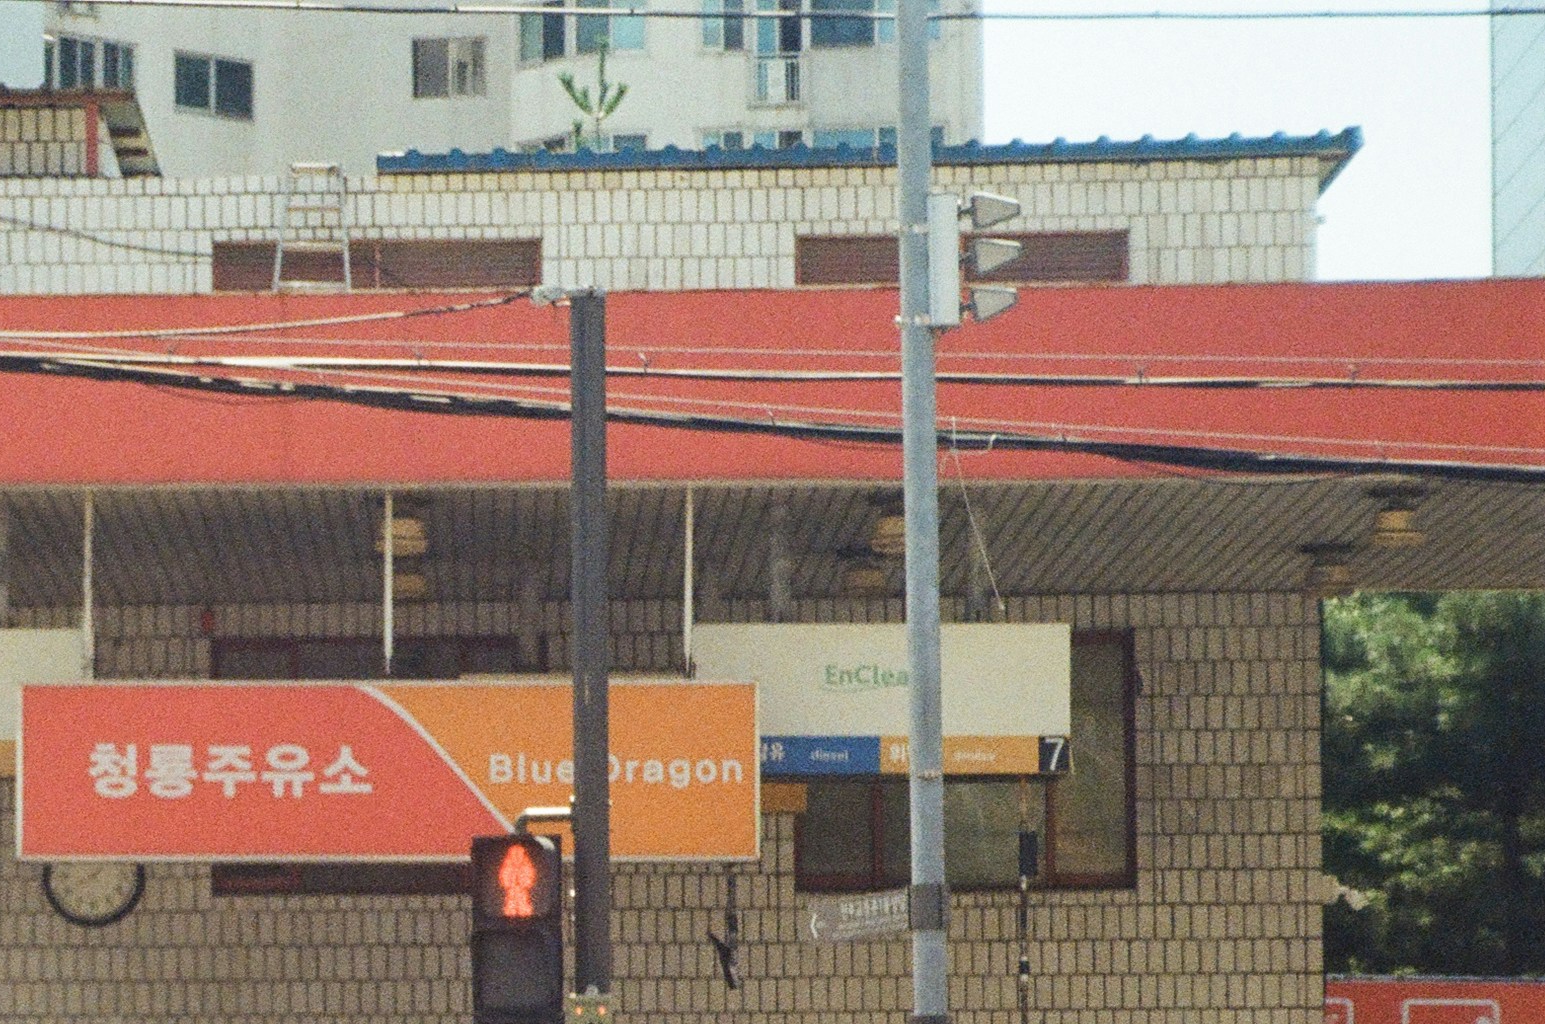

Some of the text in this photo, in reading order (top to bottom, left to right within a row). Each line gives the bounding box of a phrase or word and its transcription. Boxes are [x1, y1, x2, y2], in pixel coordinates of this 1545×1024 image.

[824, 664, 909, 688] EnClea
[489, 752, 575, 784] Blue
[760, 741, 785, 763] 유
[1045, 738, 1065, 771] 7
[88, 743, 373, 799] 청룡주유소
